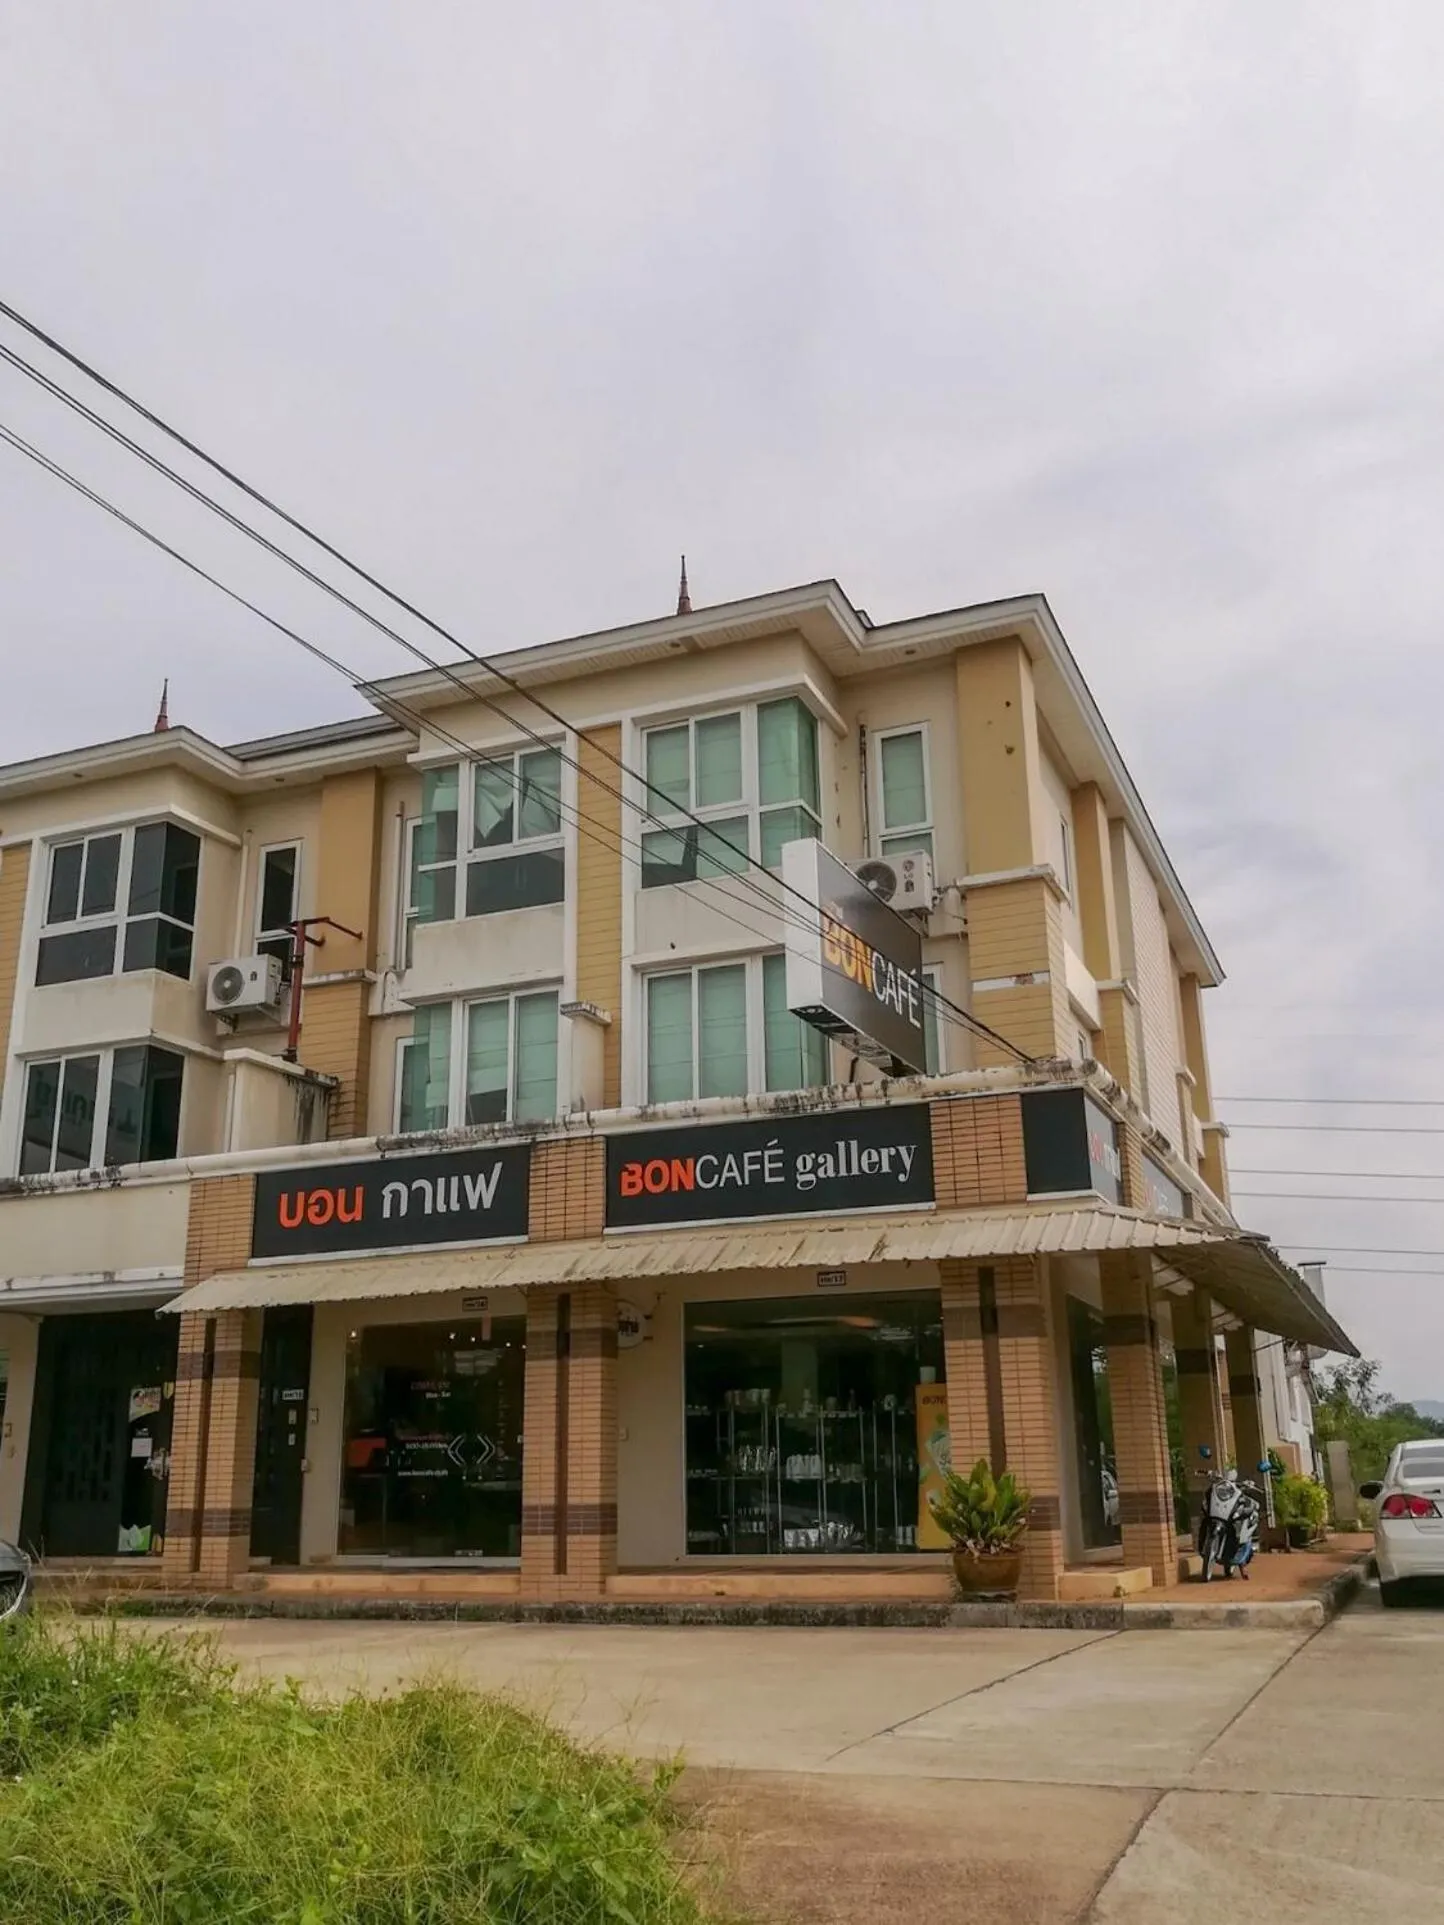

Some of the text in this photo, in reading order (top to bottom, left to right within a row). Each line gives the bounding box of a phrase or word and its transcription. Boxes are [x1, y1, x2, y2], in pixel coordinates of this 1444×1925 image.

[279, 1161, 503, 1229] บอน กาแฟ
[619, 1139, 917, 1197] BONCAFÉ gallery
